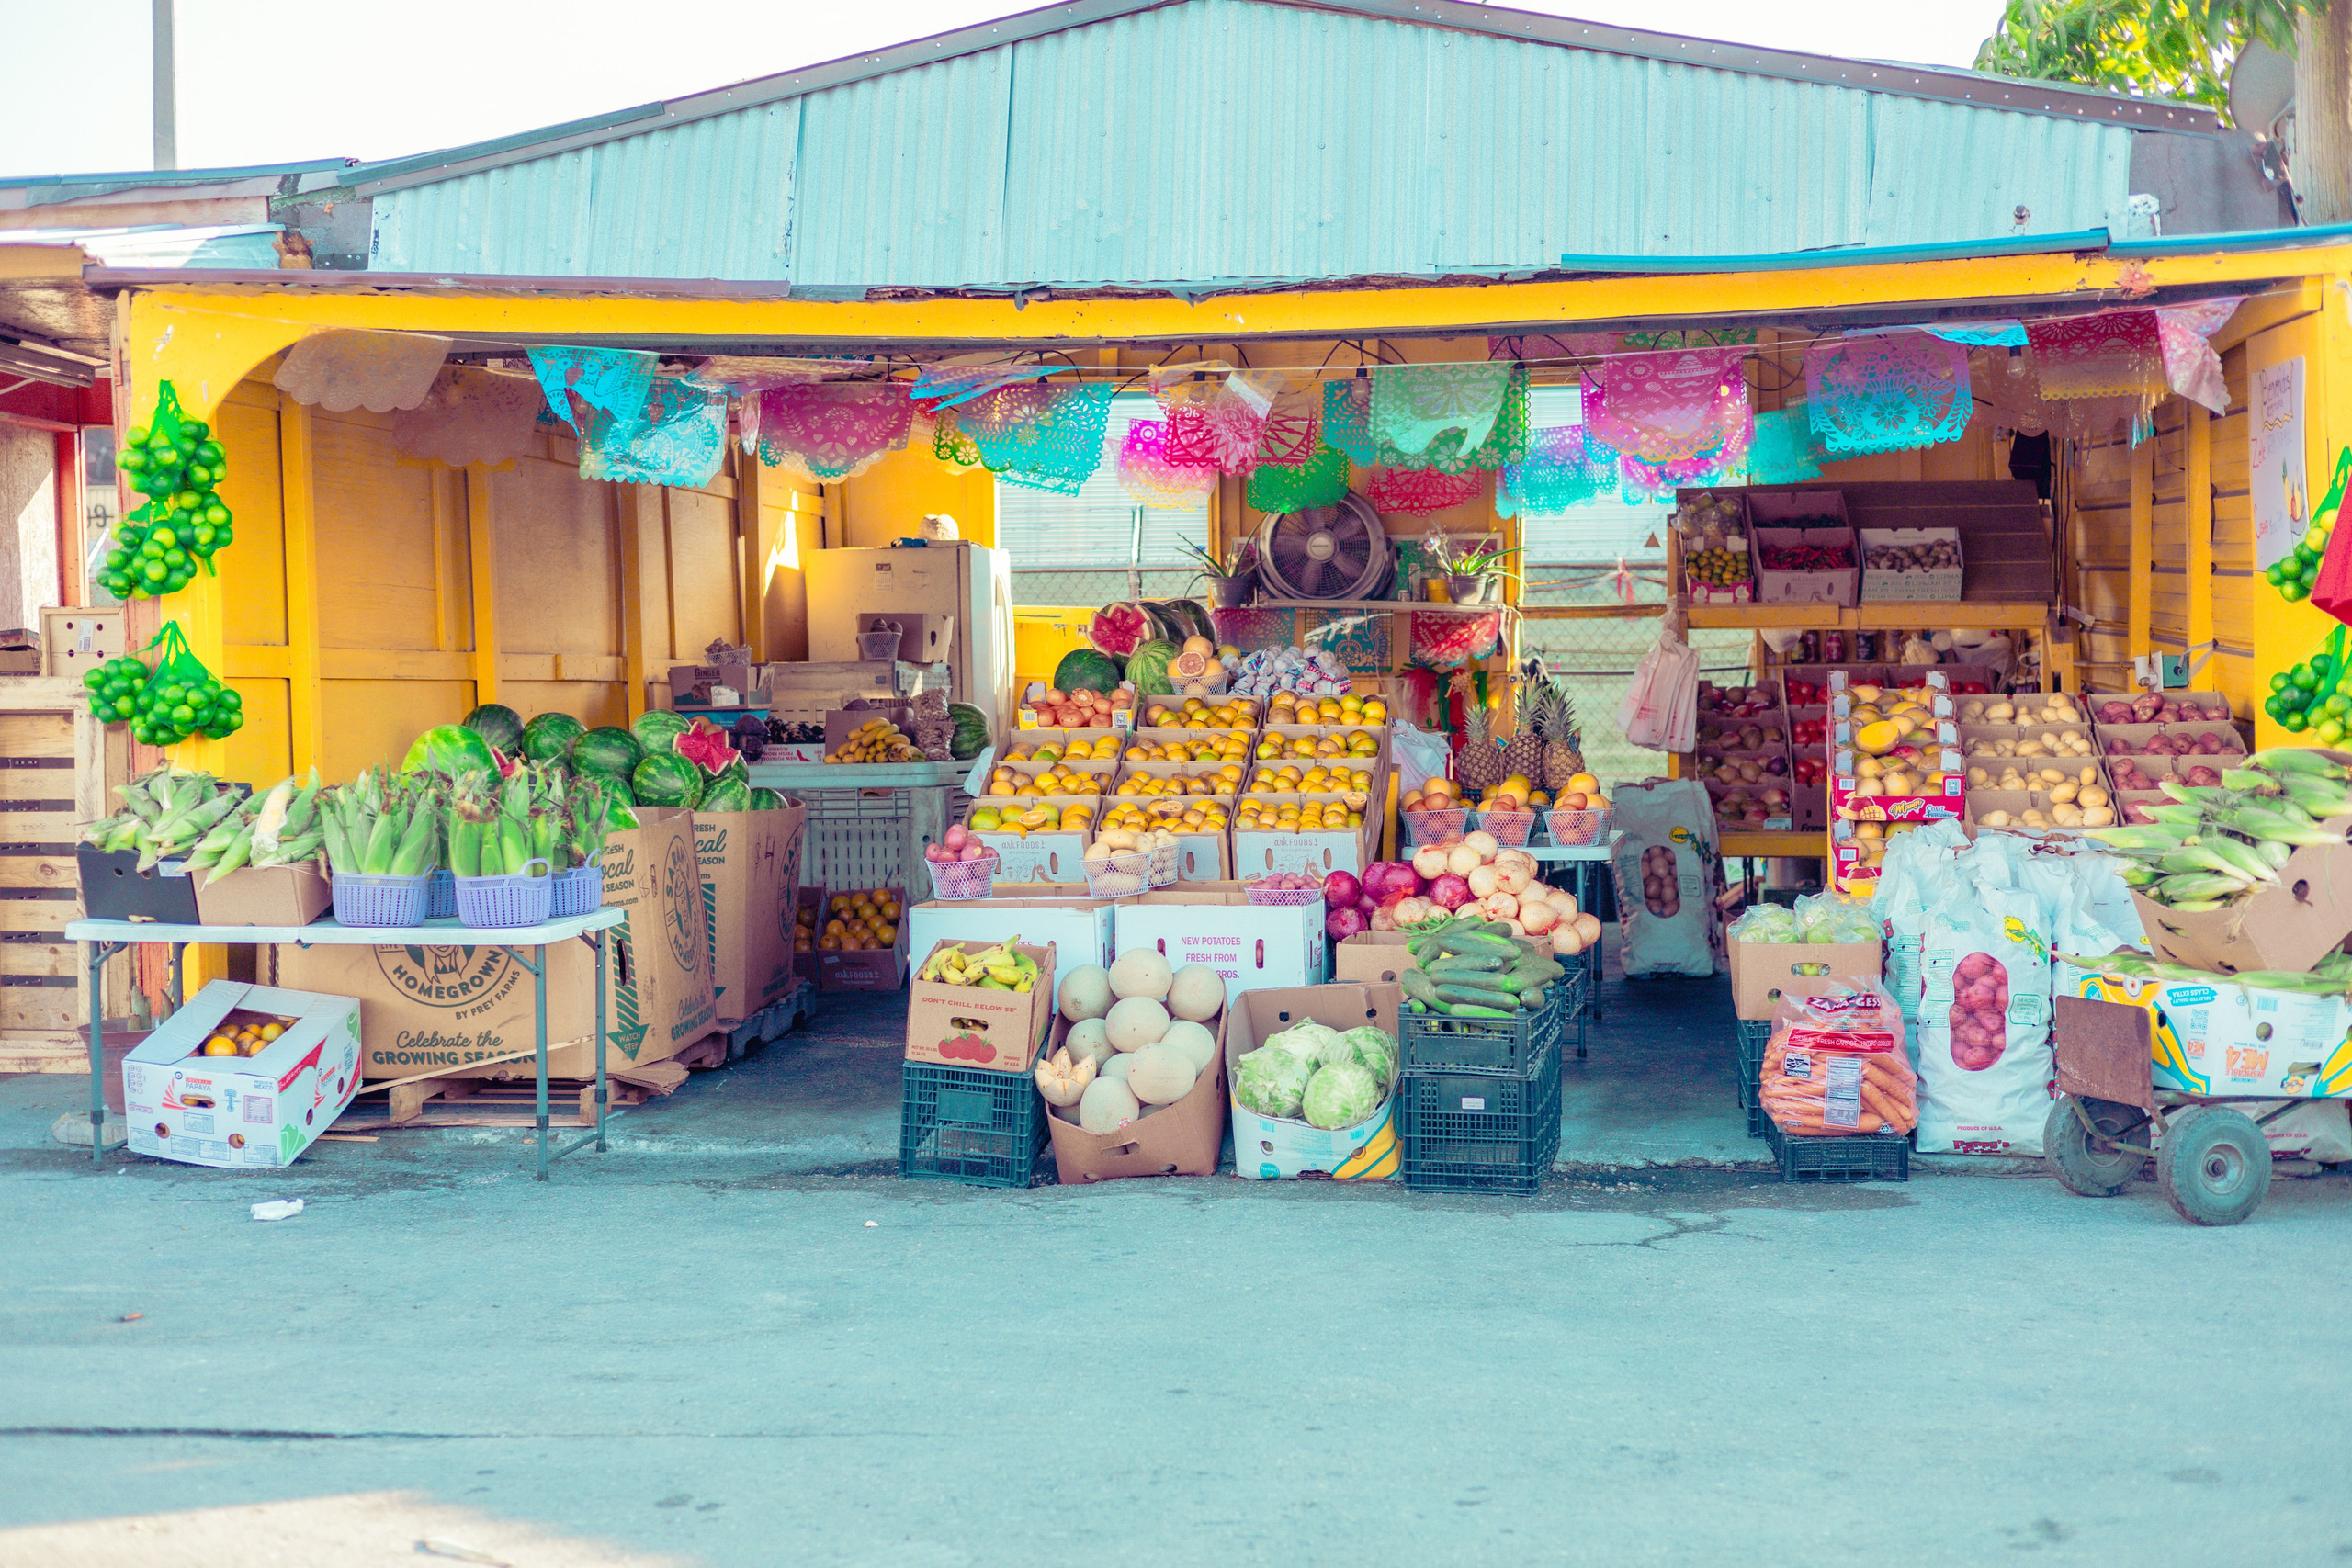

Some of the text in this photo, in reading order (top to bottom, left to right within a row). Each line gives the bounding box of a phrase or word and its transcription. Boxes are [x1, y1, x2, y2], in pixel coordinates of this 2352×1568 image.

[695, 668, 720, 678] GINGER
[694, 824, 716, 832] RESH
[695, 829, 727, 853] cal
[601, 849, 634, 880] ocal
[606, 879, 635, 892] SEASON
[1181, 936, 1241, 945] NEW POTATOES
[1185, 953, 1237, 962] FRESH FROM
[392, 949, 503, 999] HOMEGROWN
[455, 970, 520, 1020] BY FREY FARMS
[2190, 988, 2210, 997] CLASS
[922, 997, 946, 1005] DON'T
[947, 999, 972, 1009] CHILL
[974, 1003, 1003, 1011] BELOW
[396, 1030, 503, 1049] Celebrate the
[618, 1031, 641, 1043] WATCH
[624, 1042, 639, 1052] STEP
[372, 1050, 458, 1066] GROWING
[2224, 1067, 2265, 1078] DESPICABLE
[186, 1083, 211, 1091] PAPAYA
